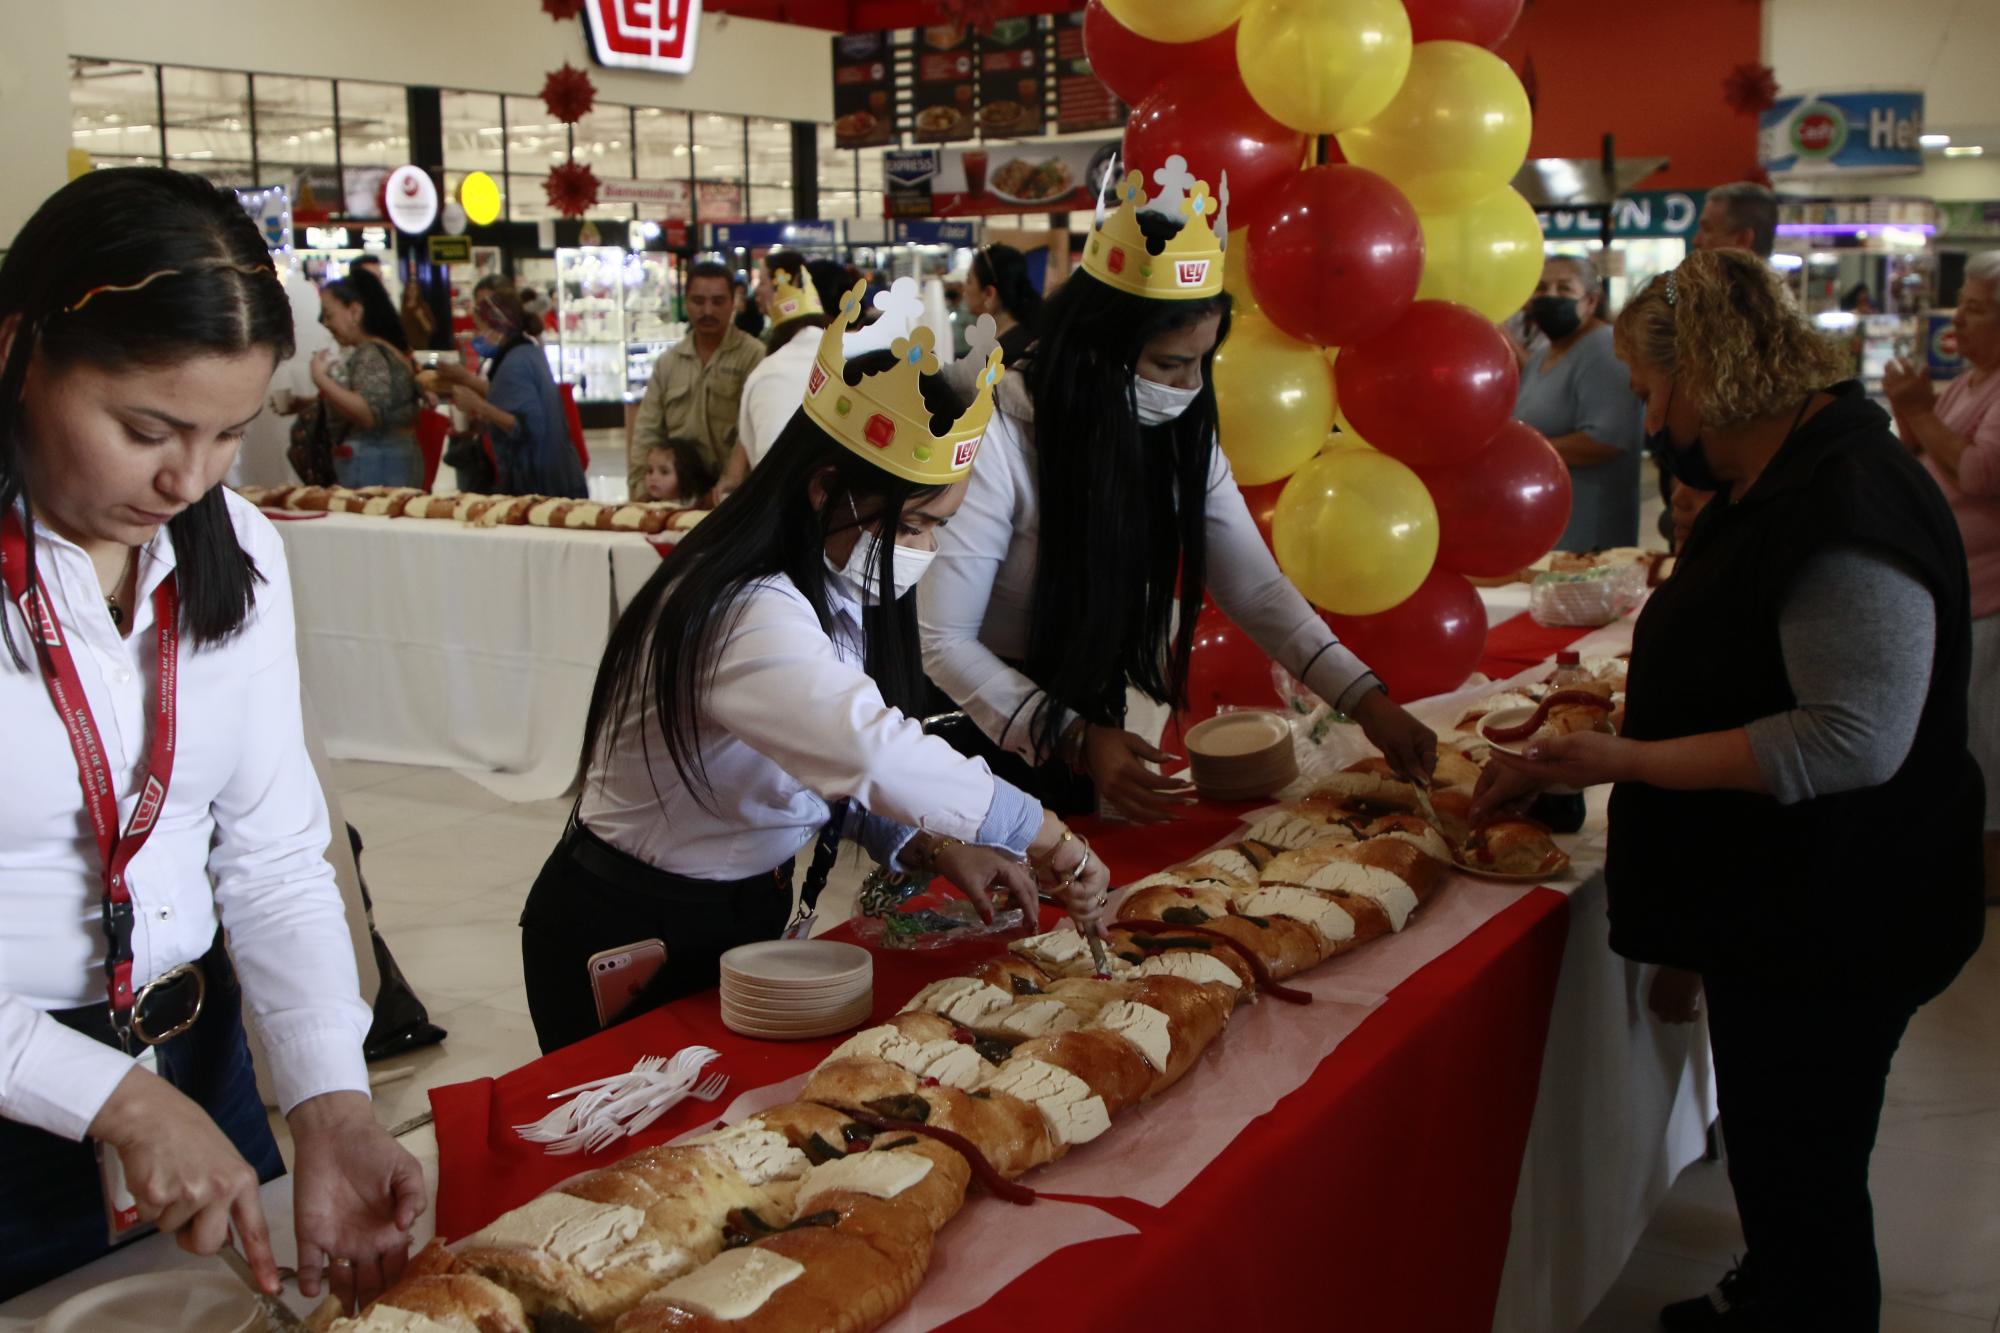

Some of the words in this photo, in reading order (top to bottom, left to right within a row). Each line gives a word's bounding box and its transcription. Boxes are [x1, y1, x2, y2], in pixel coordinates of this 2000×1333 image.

[75, 708, 97, 753] VALORES
[90, 753, 102, 768] DE
[95, 769, 108, 796] CASA
